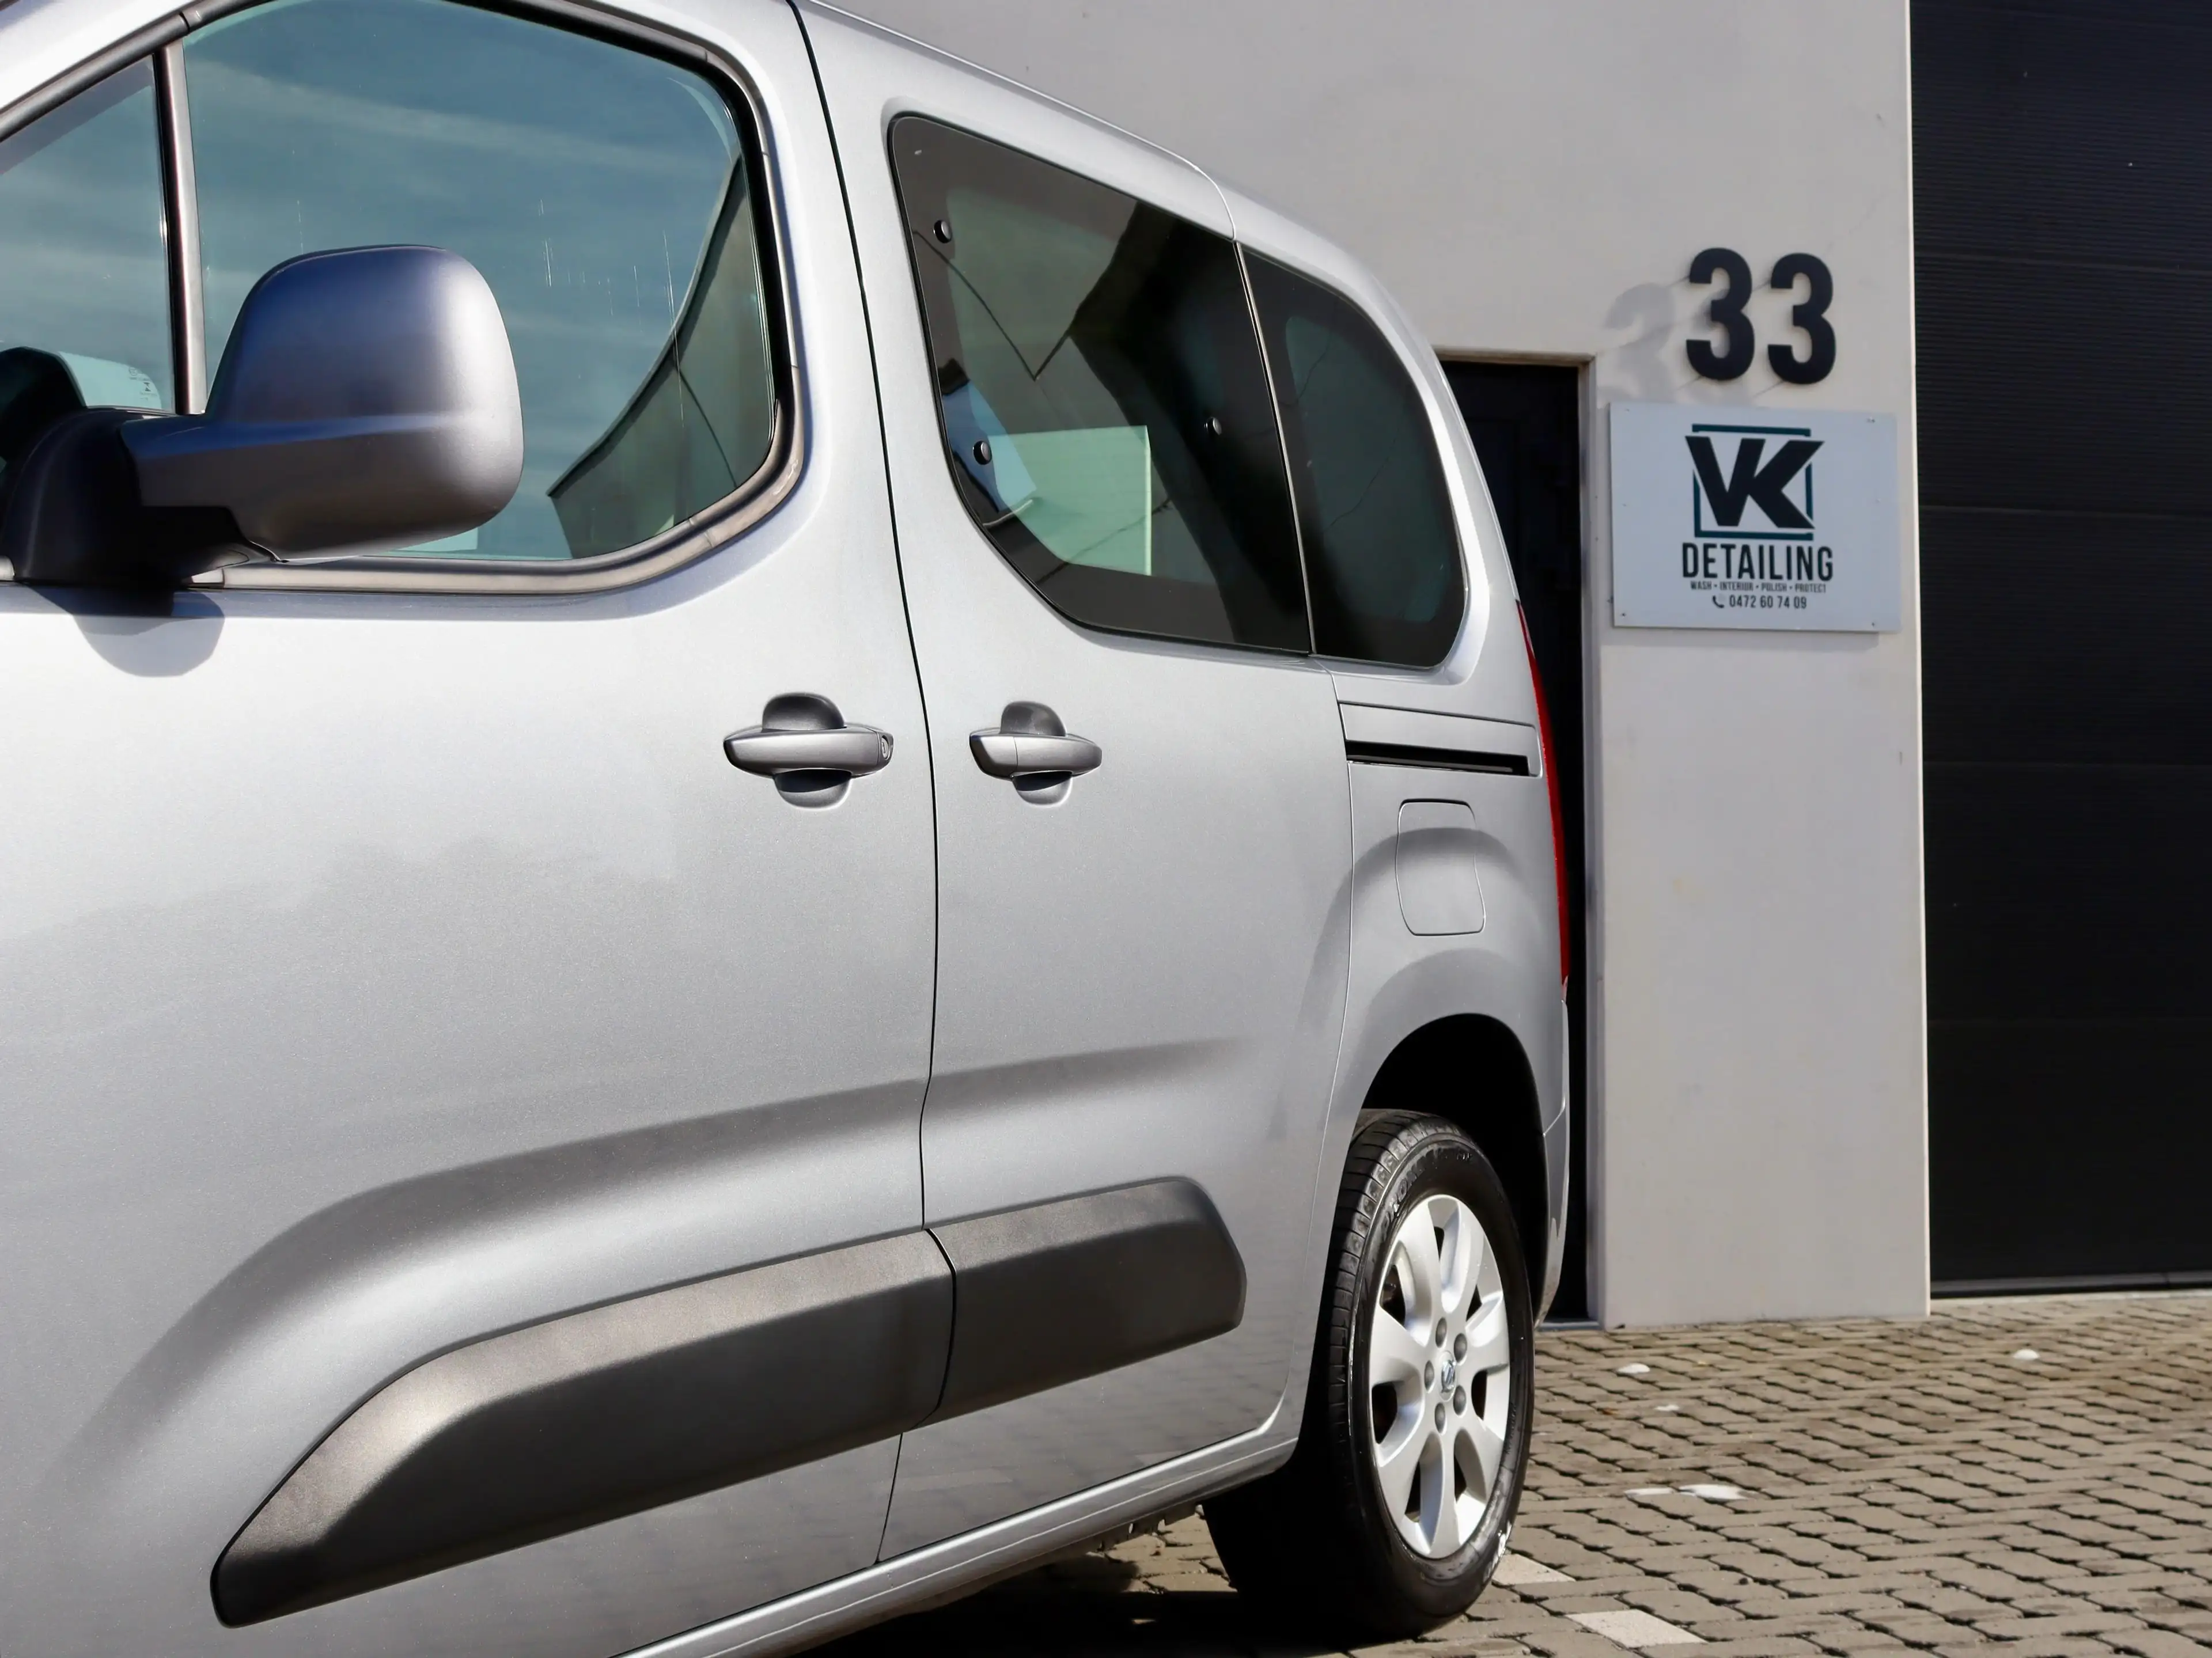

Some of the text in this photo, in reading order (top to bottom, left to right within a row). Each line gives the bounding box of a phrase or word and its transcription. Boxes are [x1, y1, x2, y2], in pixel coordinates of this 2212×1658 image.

[1686, 248, 1836, 385] 33
[1685, 436, 1823, 529] VK
[1681, 542, 1834, 582] DETAILING
[1690, 581, 1827, 594] WASH INTERIOR POLISH PROTECT
[1729, 594, 1807, 609] 0472 60 74 09
